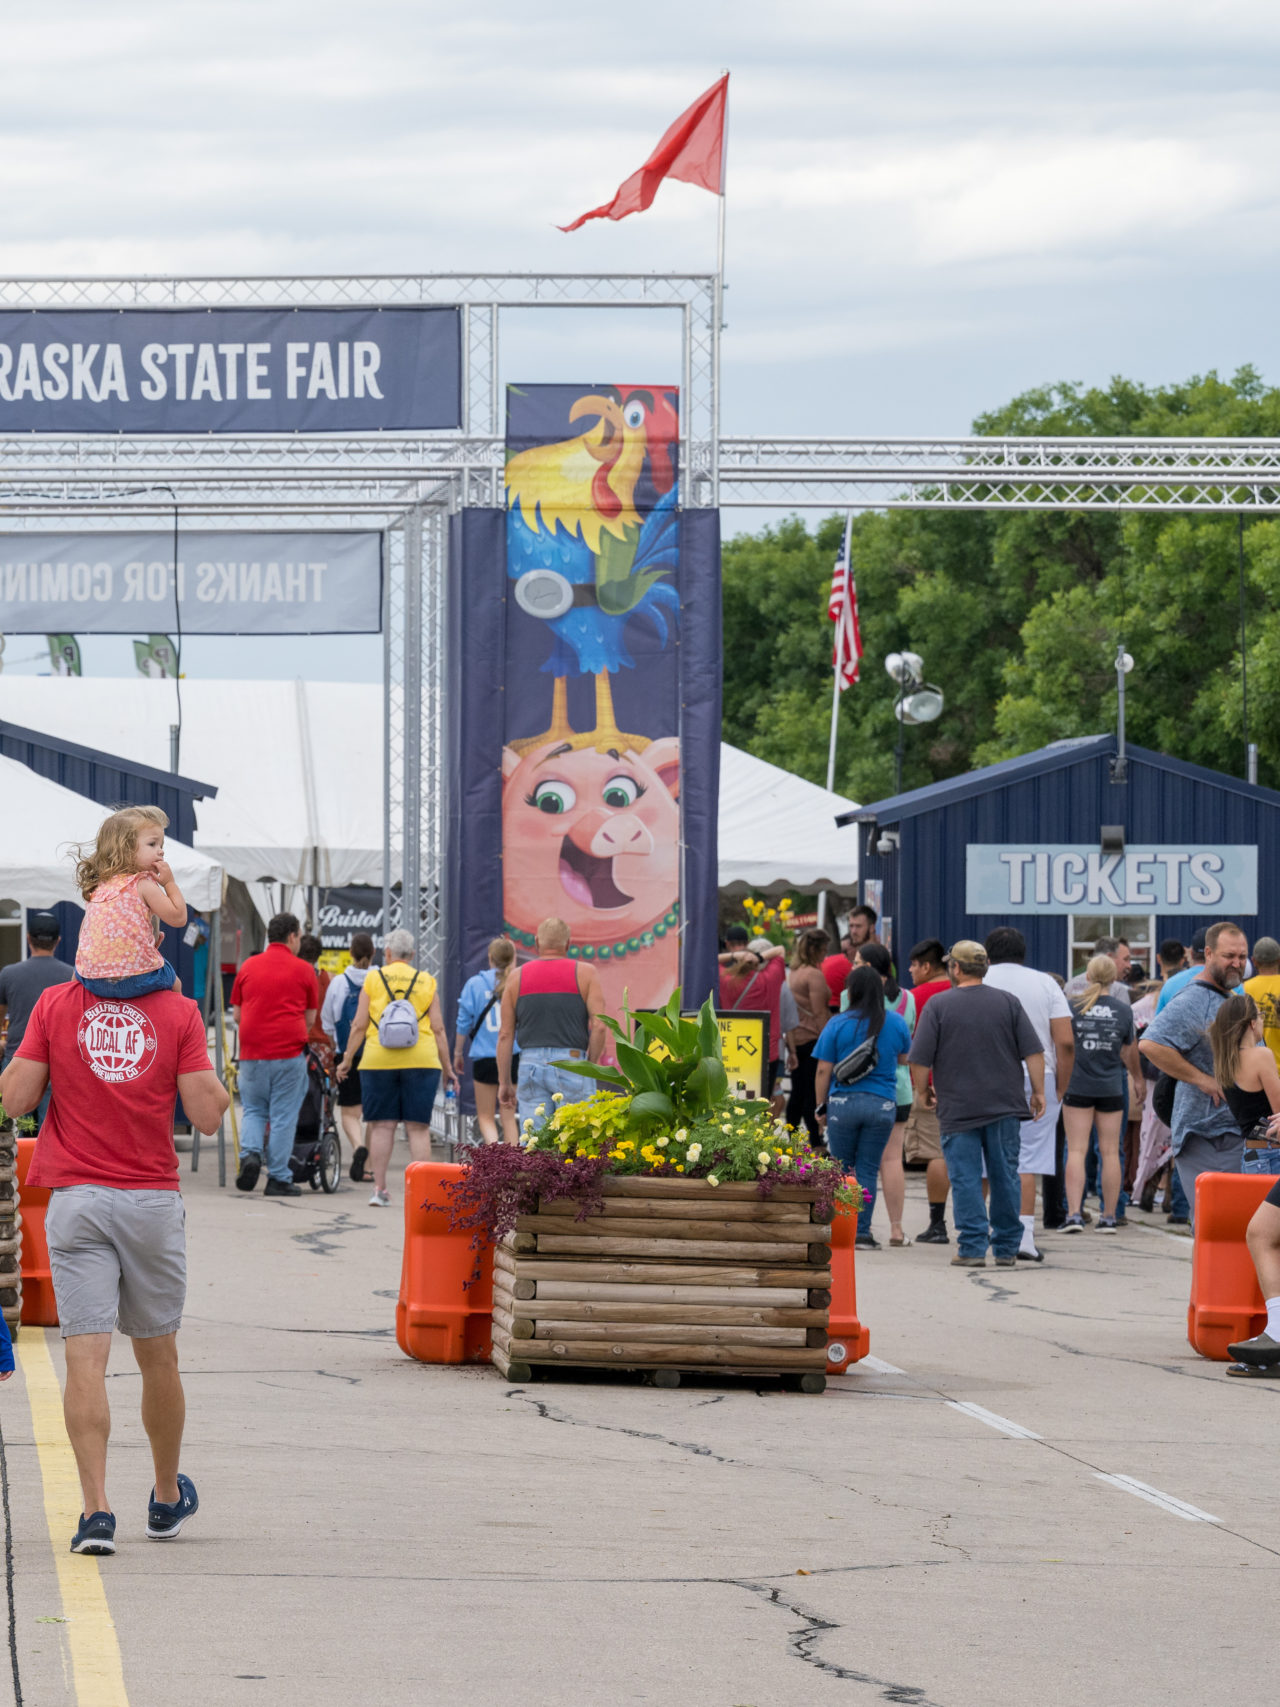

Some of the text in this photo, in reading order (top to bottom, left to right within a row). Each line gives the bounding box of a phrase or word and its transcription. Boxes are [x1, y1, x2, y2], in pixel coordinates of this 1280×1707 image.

[140, 342, 272, 402] STATE
[286, 341, 385, 400] FAIR
[999, 852, 1225, 906] TICKETS
[318, 904, 384, 928] Bristol
[84, 1004, 147, 1026] BULLFROG CREEK
[89, 1025, 140, 1055] LOCAL AF
[89, 1063, 125, 1081] BREWING
